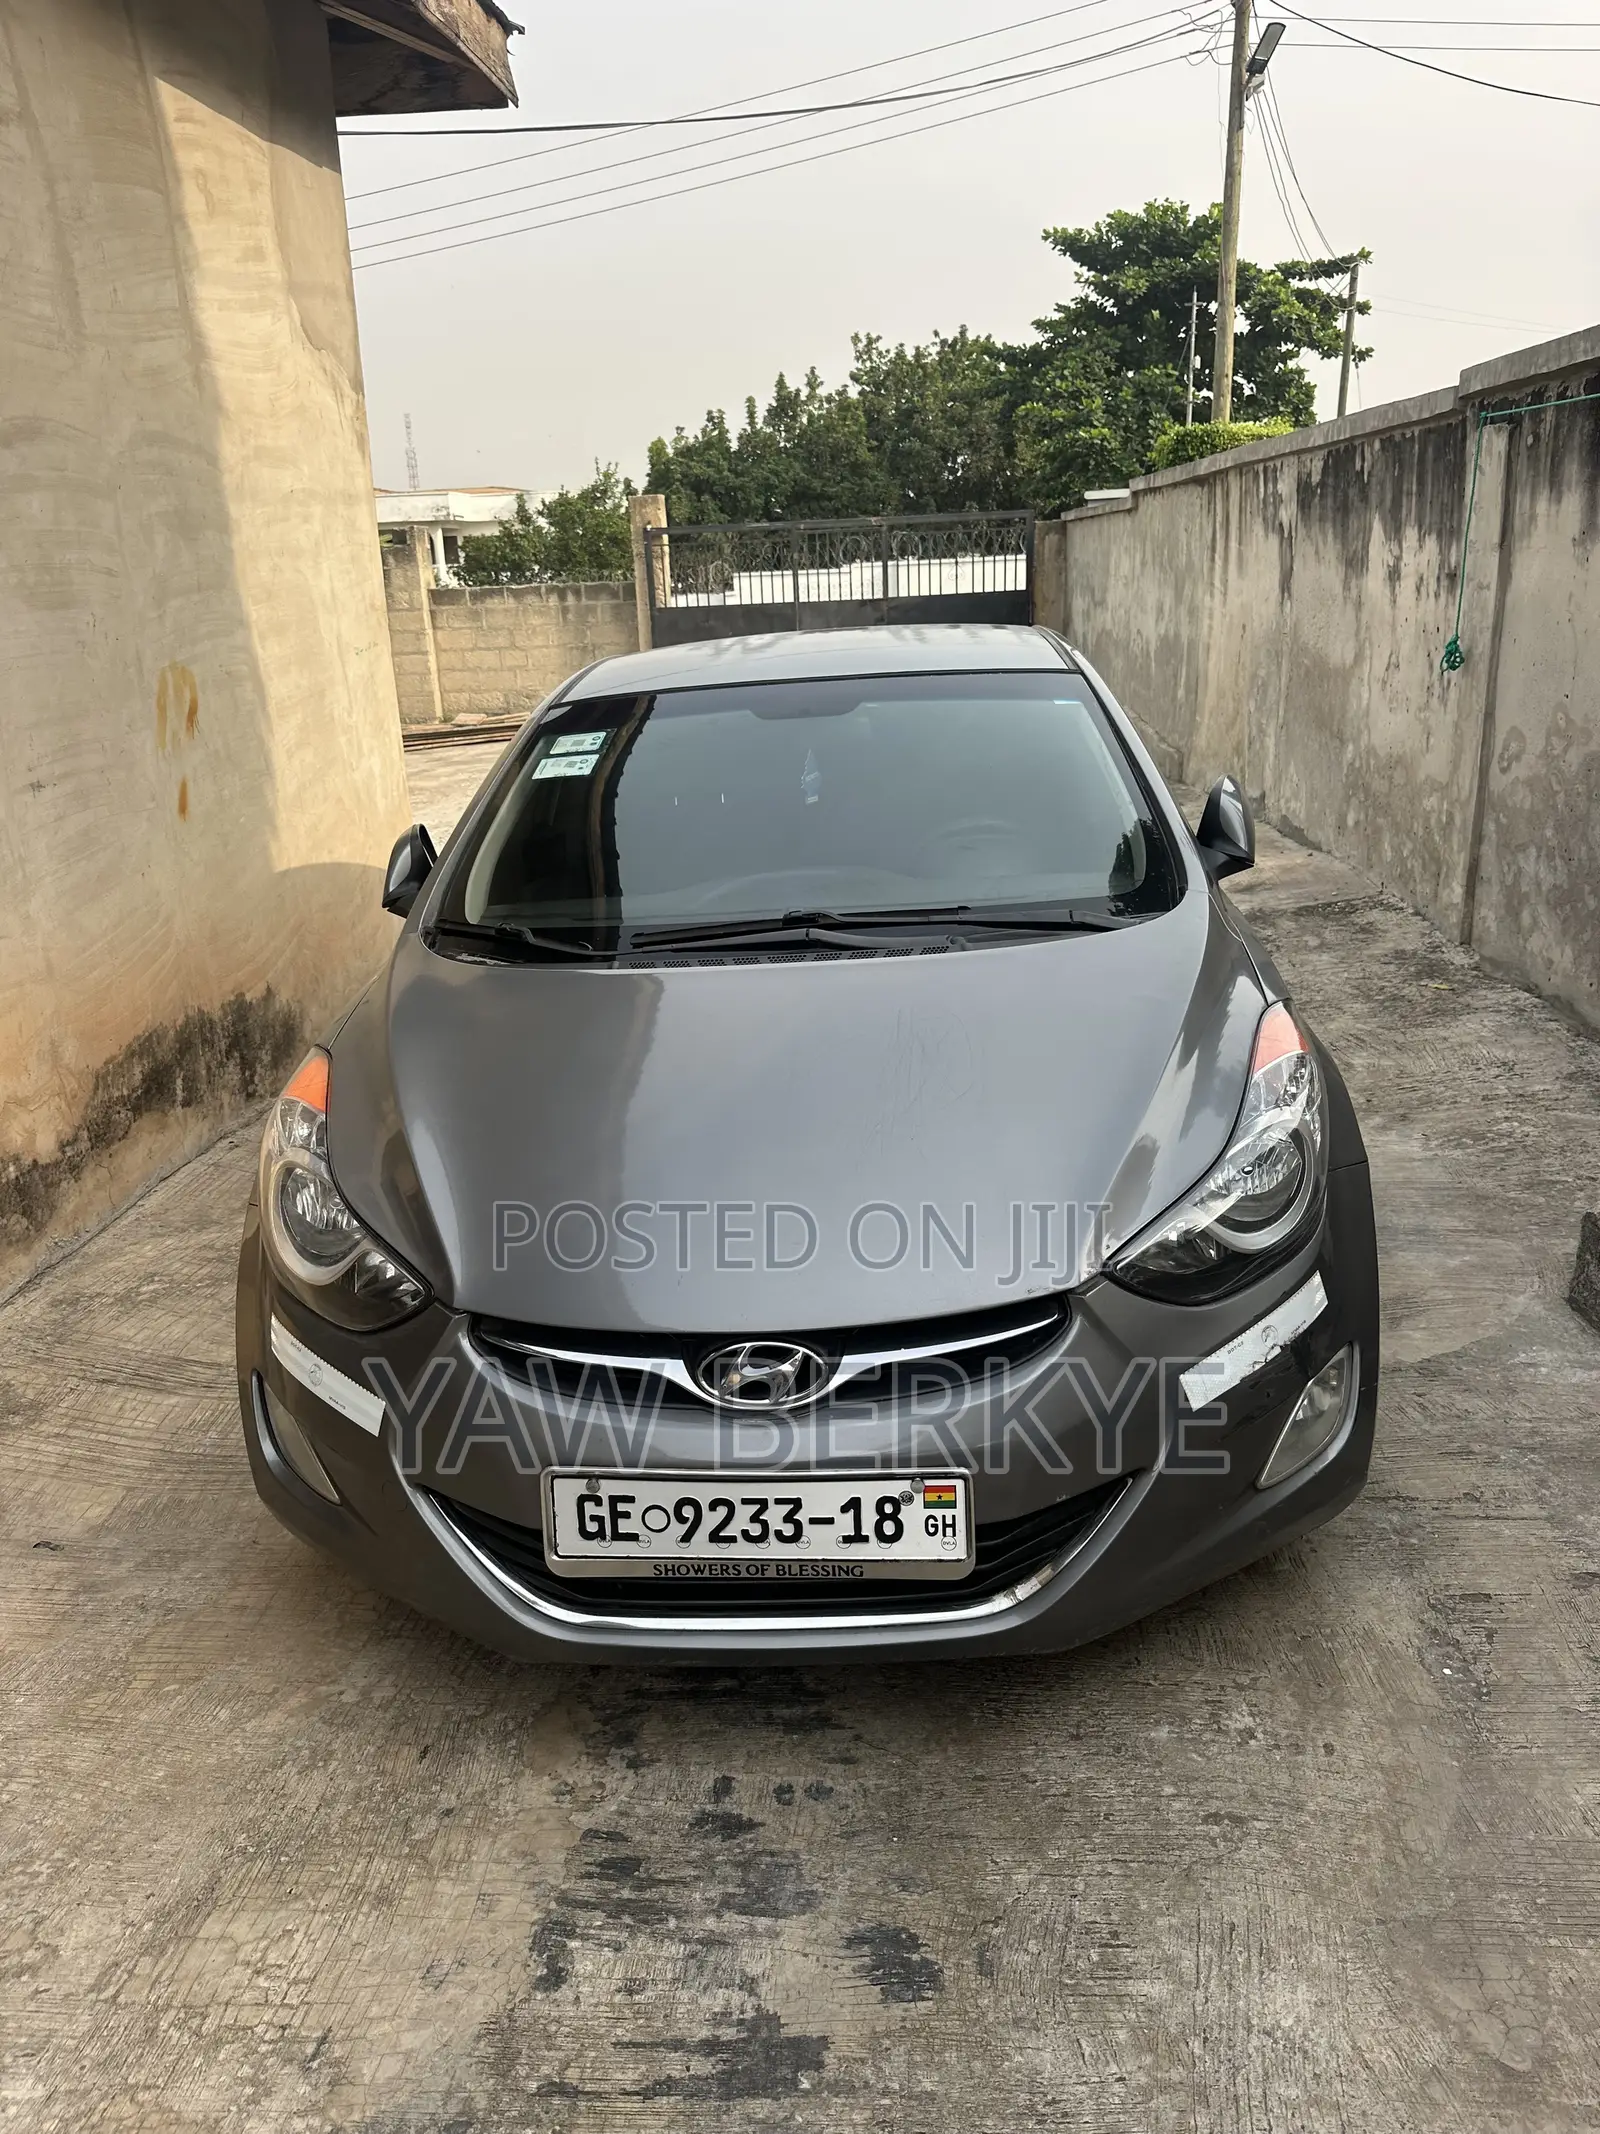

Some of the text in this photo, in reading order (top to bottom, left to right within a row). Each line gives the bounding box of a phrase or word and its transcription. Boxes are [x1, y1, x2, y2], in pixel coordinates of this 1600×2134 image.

[576, 1494, 904, 1544] GE 9233-18
[924, 1514, 956, 1537] GH
[653, 1563, 864, 1578] SHOWERS OF BLESSING
